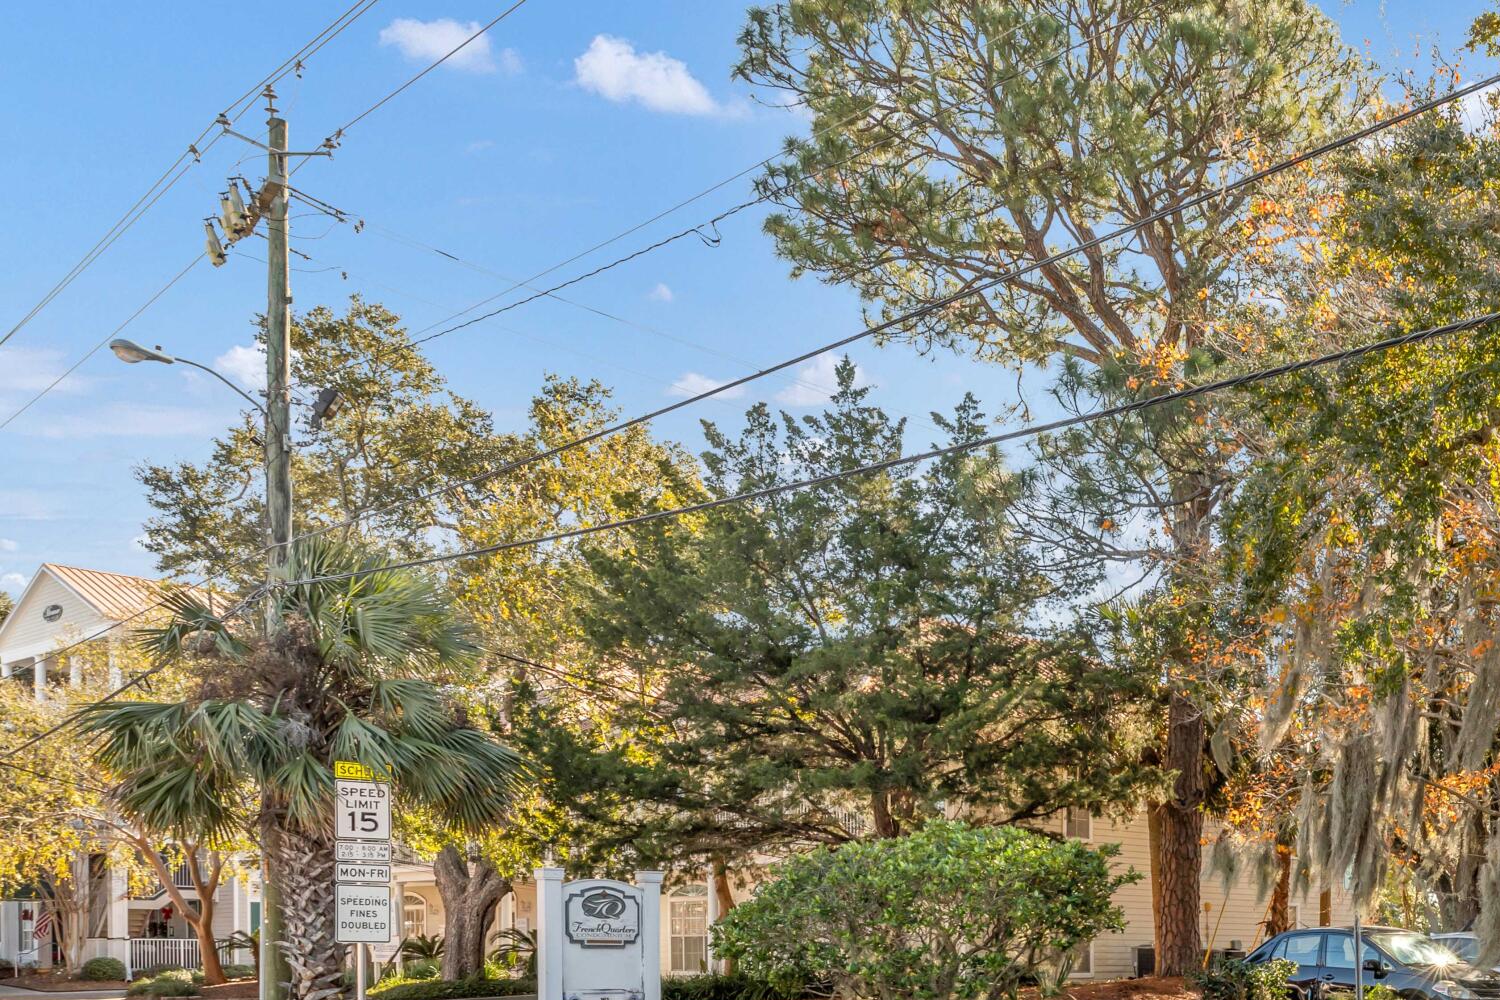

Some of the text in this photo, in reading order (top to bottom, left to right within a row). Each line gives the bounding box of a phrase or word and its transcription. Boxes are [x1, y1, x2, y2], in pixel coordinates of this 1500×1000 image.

[340, 765, 386, 778] SCH
[341, 787, 386, 798] SPEED
[346, 799, 380, 809] LIMIT
[348, 811, 379, 832] 15
[340, 868, 388, 878] MON-FRI
[340, 897, 388, 907] SPEEDING
[350, 909, 378, 918] FINES
[341, 921, 387, 930] DOUBLED
